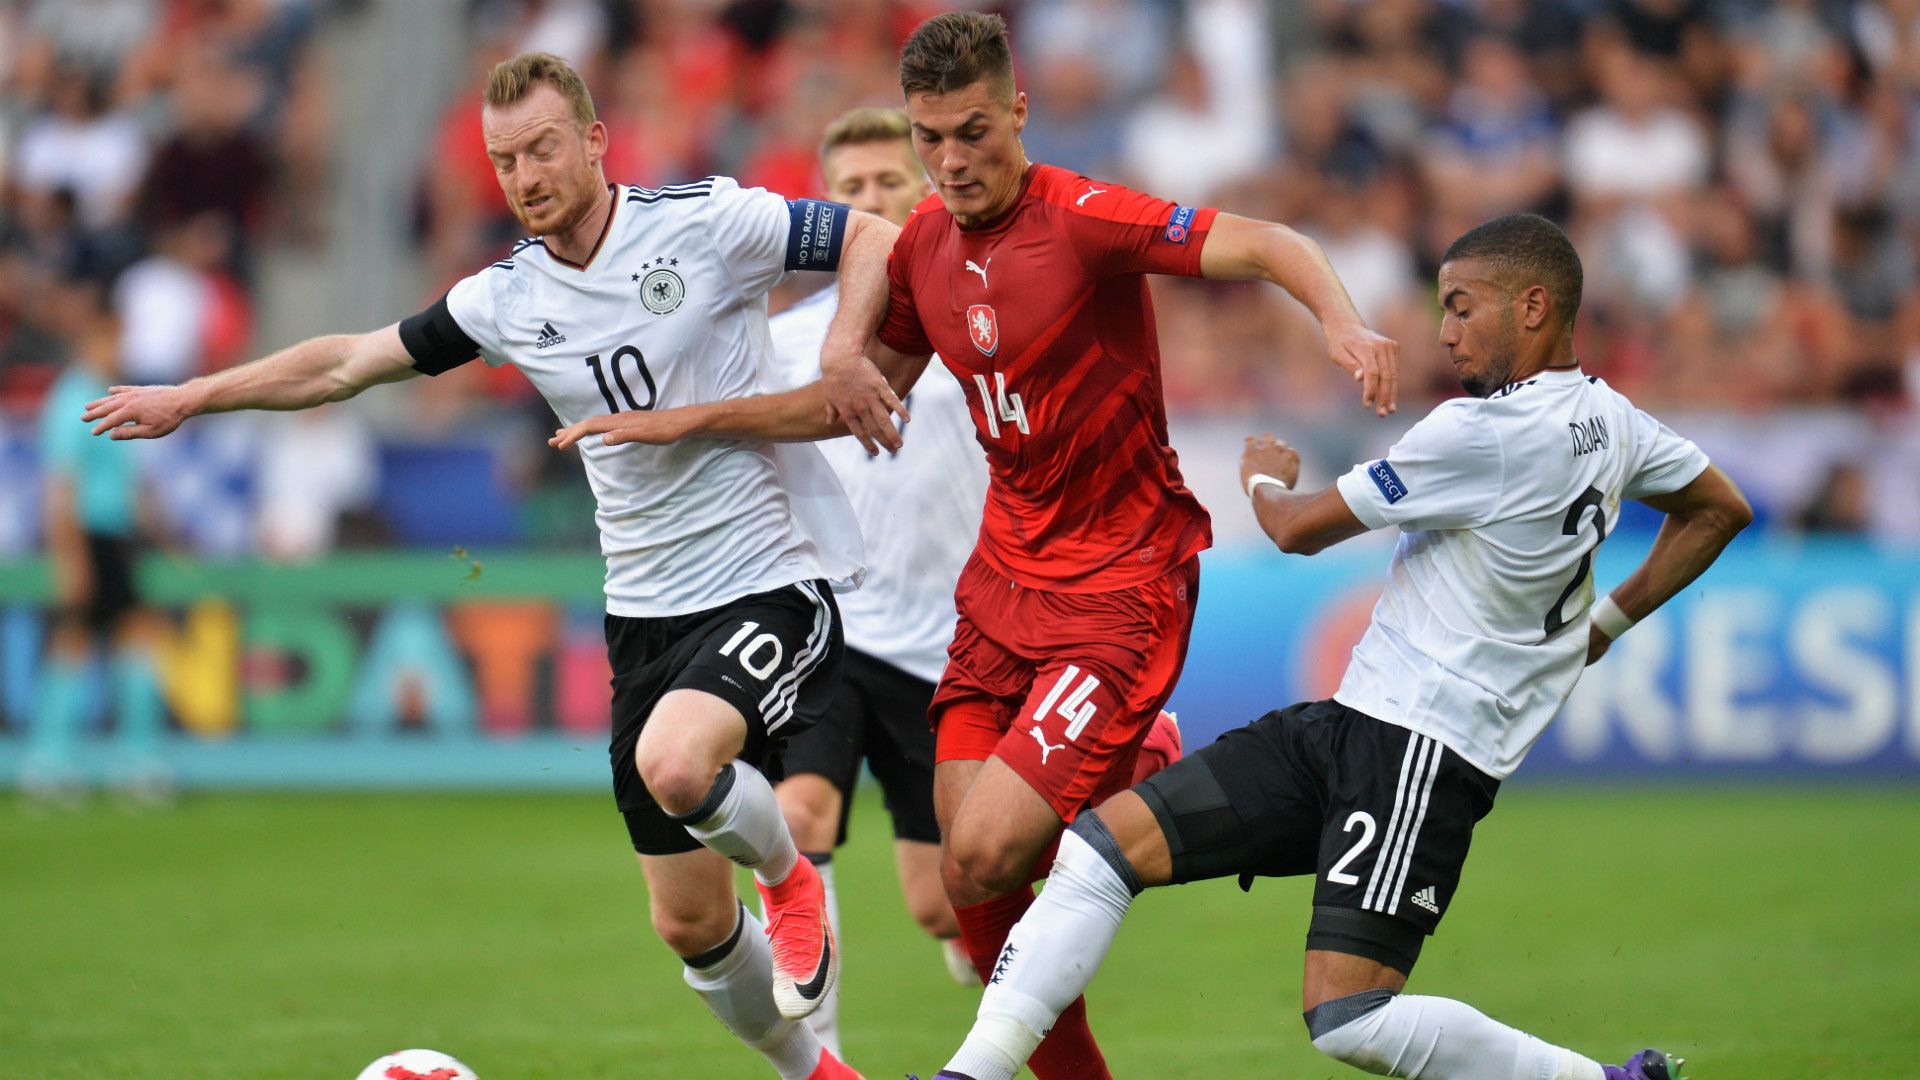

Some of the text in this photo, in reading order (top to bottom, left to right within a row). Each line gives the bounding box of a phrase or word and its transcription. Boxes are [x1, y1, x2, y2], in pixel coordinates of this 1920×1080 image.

[799, 250, 808, 265] NO
[801, 234, 810, 249] TO
[818, 206, 832, 247] RESPECT
[536, 334, 567, 350] adidas
[585, 345, 657, 414] 10
[973, 371, 1030, 438] 14
[1544, 485, 1606, 637] 2
[718, 621, 783, 680] 10
[1563, 590, 1920, 762] RES
[1032, 663, 1100, 742] 14
[1326, 810, 1377, 886] 2
[1411, 895, 1439, 913] adidas
